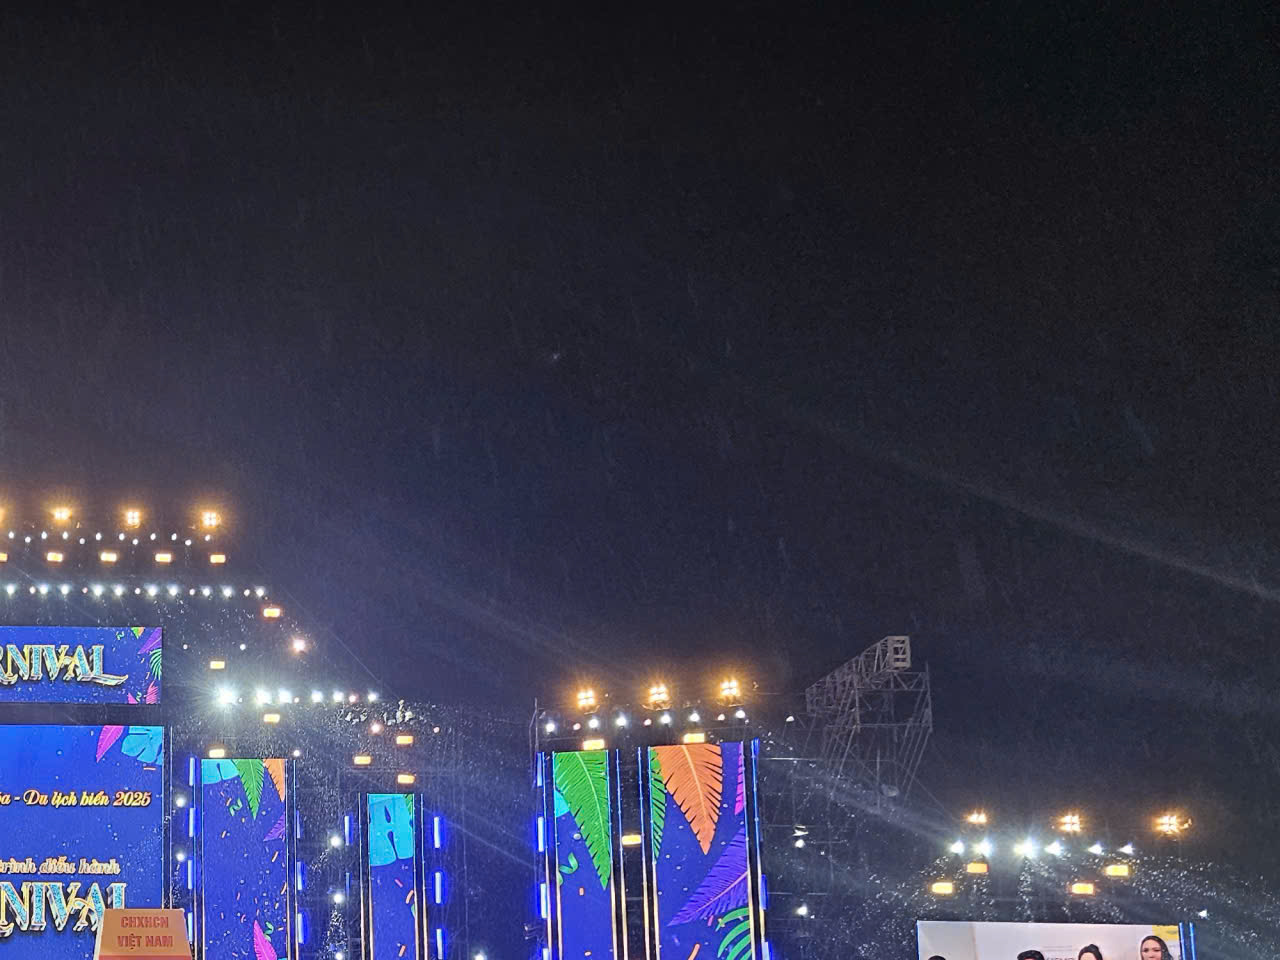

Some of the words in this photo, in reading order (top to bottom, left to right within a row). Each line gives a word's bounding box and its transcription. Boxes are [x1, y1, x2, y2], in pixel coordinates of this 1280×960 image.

[23, 789, 48, 805] Du
[51, 790, 77, 808] lịch
[80, 789, 109, 806] biển
[112, 790, 151, 806] 2025
[39, 855, 77, 874] diễu
[79, 858, 121, 874] hành
[120, 916, 169, 929] CHXHCN
[117, 932, 142, 950] VIỆT
[146, 935, 174, 948] NAM
